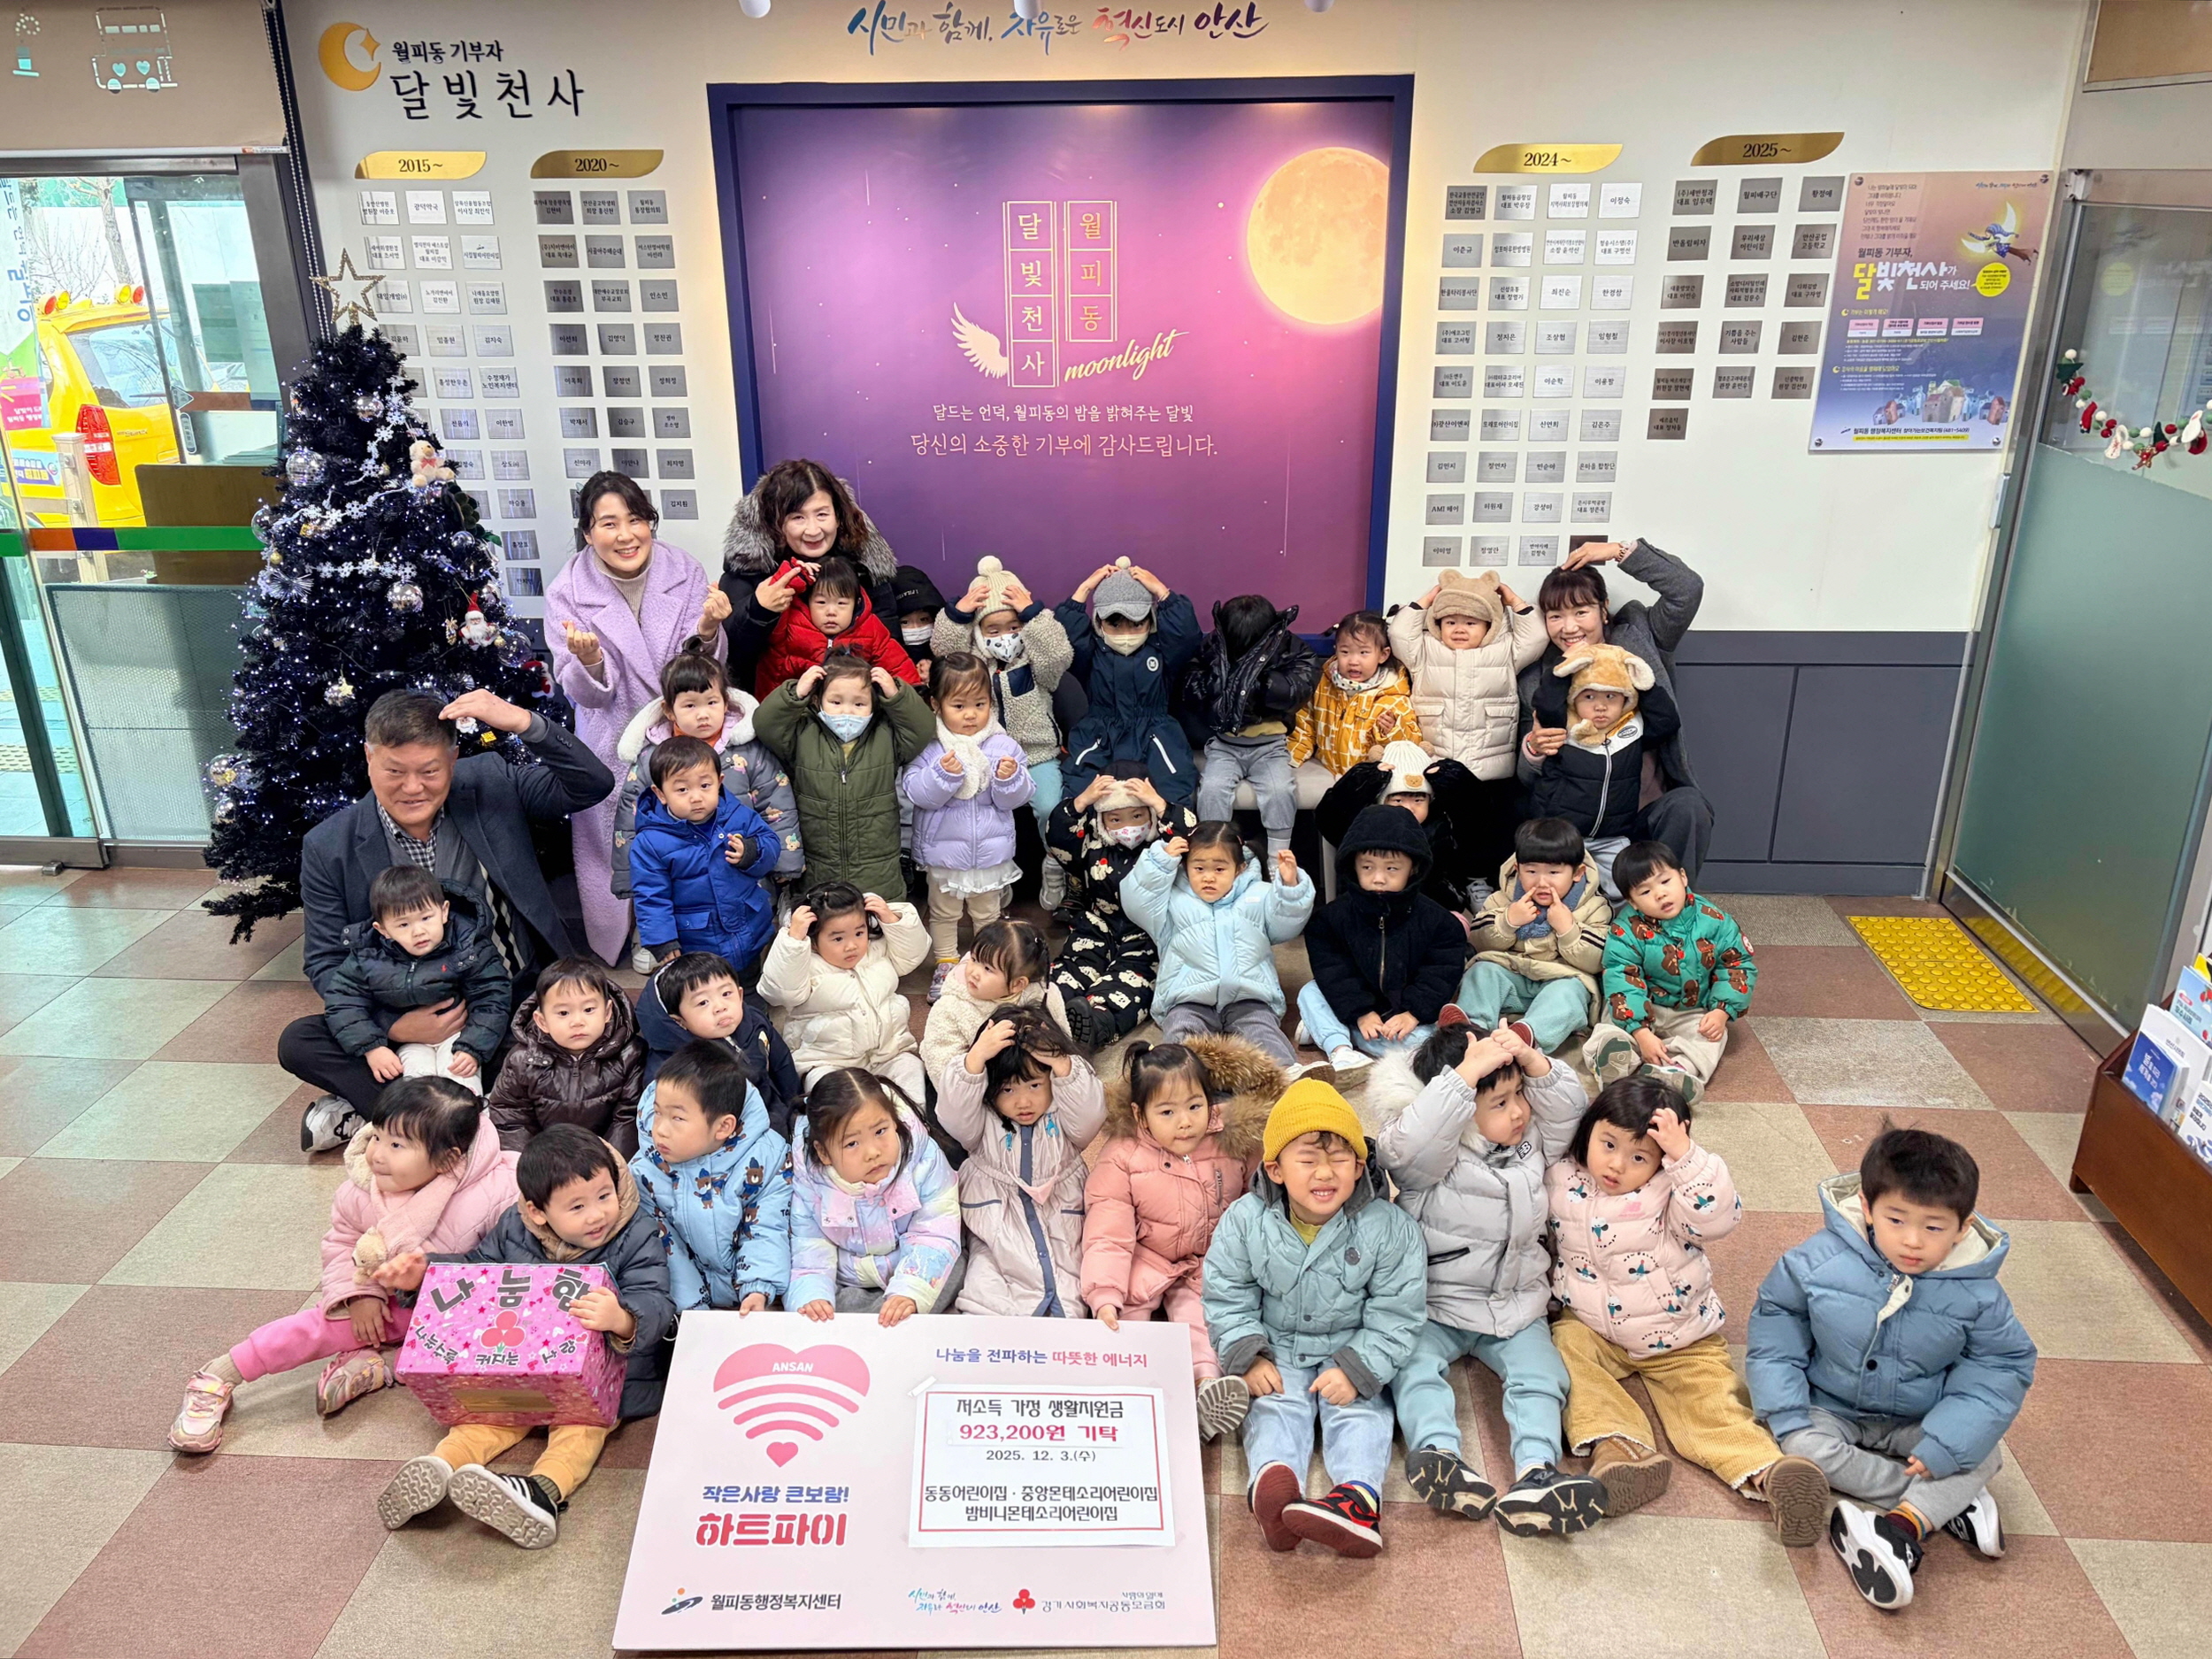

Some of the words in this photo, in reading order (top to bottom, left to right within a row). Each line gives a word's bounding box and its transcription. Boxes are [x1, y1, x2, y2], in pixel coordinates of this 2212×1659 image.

[1092, 7, 1185, 50] 혁신도시
[1194, 2, 1270, 40] 안산
[391, 41, 446, 64] 월피동
[450, 40, 504, 62] 기부자
[1676, 197, 1689, 207] 대표
[1742, 189, 1779, 201] 월피배구단
[1671, 238, 1708, 249] 반올림피자
[1740, 233, 1765, 242] 우리세상
[1739, 242, 1766, 252] 어린이집
[1799, 241, 1825, 252] 고등학교
[1079, 211, 1102, 332] 월피동
[1018, 211, 1045, 378] 달빛천사
[1730, 294, 1741, 303] 대표
[1790, 290, 1801, 299] 대표
[1745, 328, 1757, 338] 주는
[1064, 329, 1190, 382] moonlight
[933, 403, 973, 422] 달드는
[979, 403, 1010, 422] 언덕,
[1013, 403, 1069, 421] 월피동의
[1074, 404, 1101, 422] 밤을
[1106, 404, 1161, 422] 밝혀주는
[1166, 403, 1194, 423] 달빛
[910, 434, 967, 456] 당신의
[973, 434, 1029, 456] 소중한
[1035, 434, 1091, 455] 기부에
[1098, 434, 1218, 457] 감사드립니다.
[936, 1348, 981, 1363] 나눔을
[987, 1349, 1048, 1364] 전파하는
[1053, 1351, 1098, 1365] 따뜻한
[1102, 1352, 1148, 1367] 에너지
[772, 1363, 813, 1372] ANSAN
[956, 1400, 1002, 1416] 저소득
[1014, 1400, 1041, 1417] 가정
[1048, 1401, 1124, 1418] 생활지원금
[959, 1425, 1065, 1441] 923,200원
[1078, 1425, 1118, 1441] 기탁
[987, 1450, 1025, 1461] 2025.
[1033, 1450, 1053, 1462] 12.
[1061, 1451, 1096, 1463] 3.(수)
[703, 1486, 779, 1503] 작은사랑
[785, 1486, 849, 1503] 큰보람!
[925, 1486, 1008, 1502] 동동어린이집
[1021, 1486, 1158, 1502] 중앙몬테소리어린이집
[965, 1506, 1118, 1522] 밤비니몬테소리어린이집
[696, 1513, 848, 1547] 하트파이
[711, 1594, 841, 1610] 월피동행정복지센터
